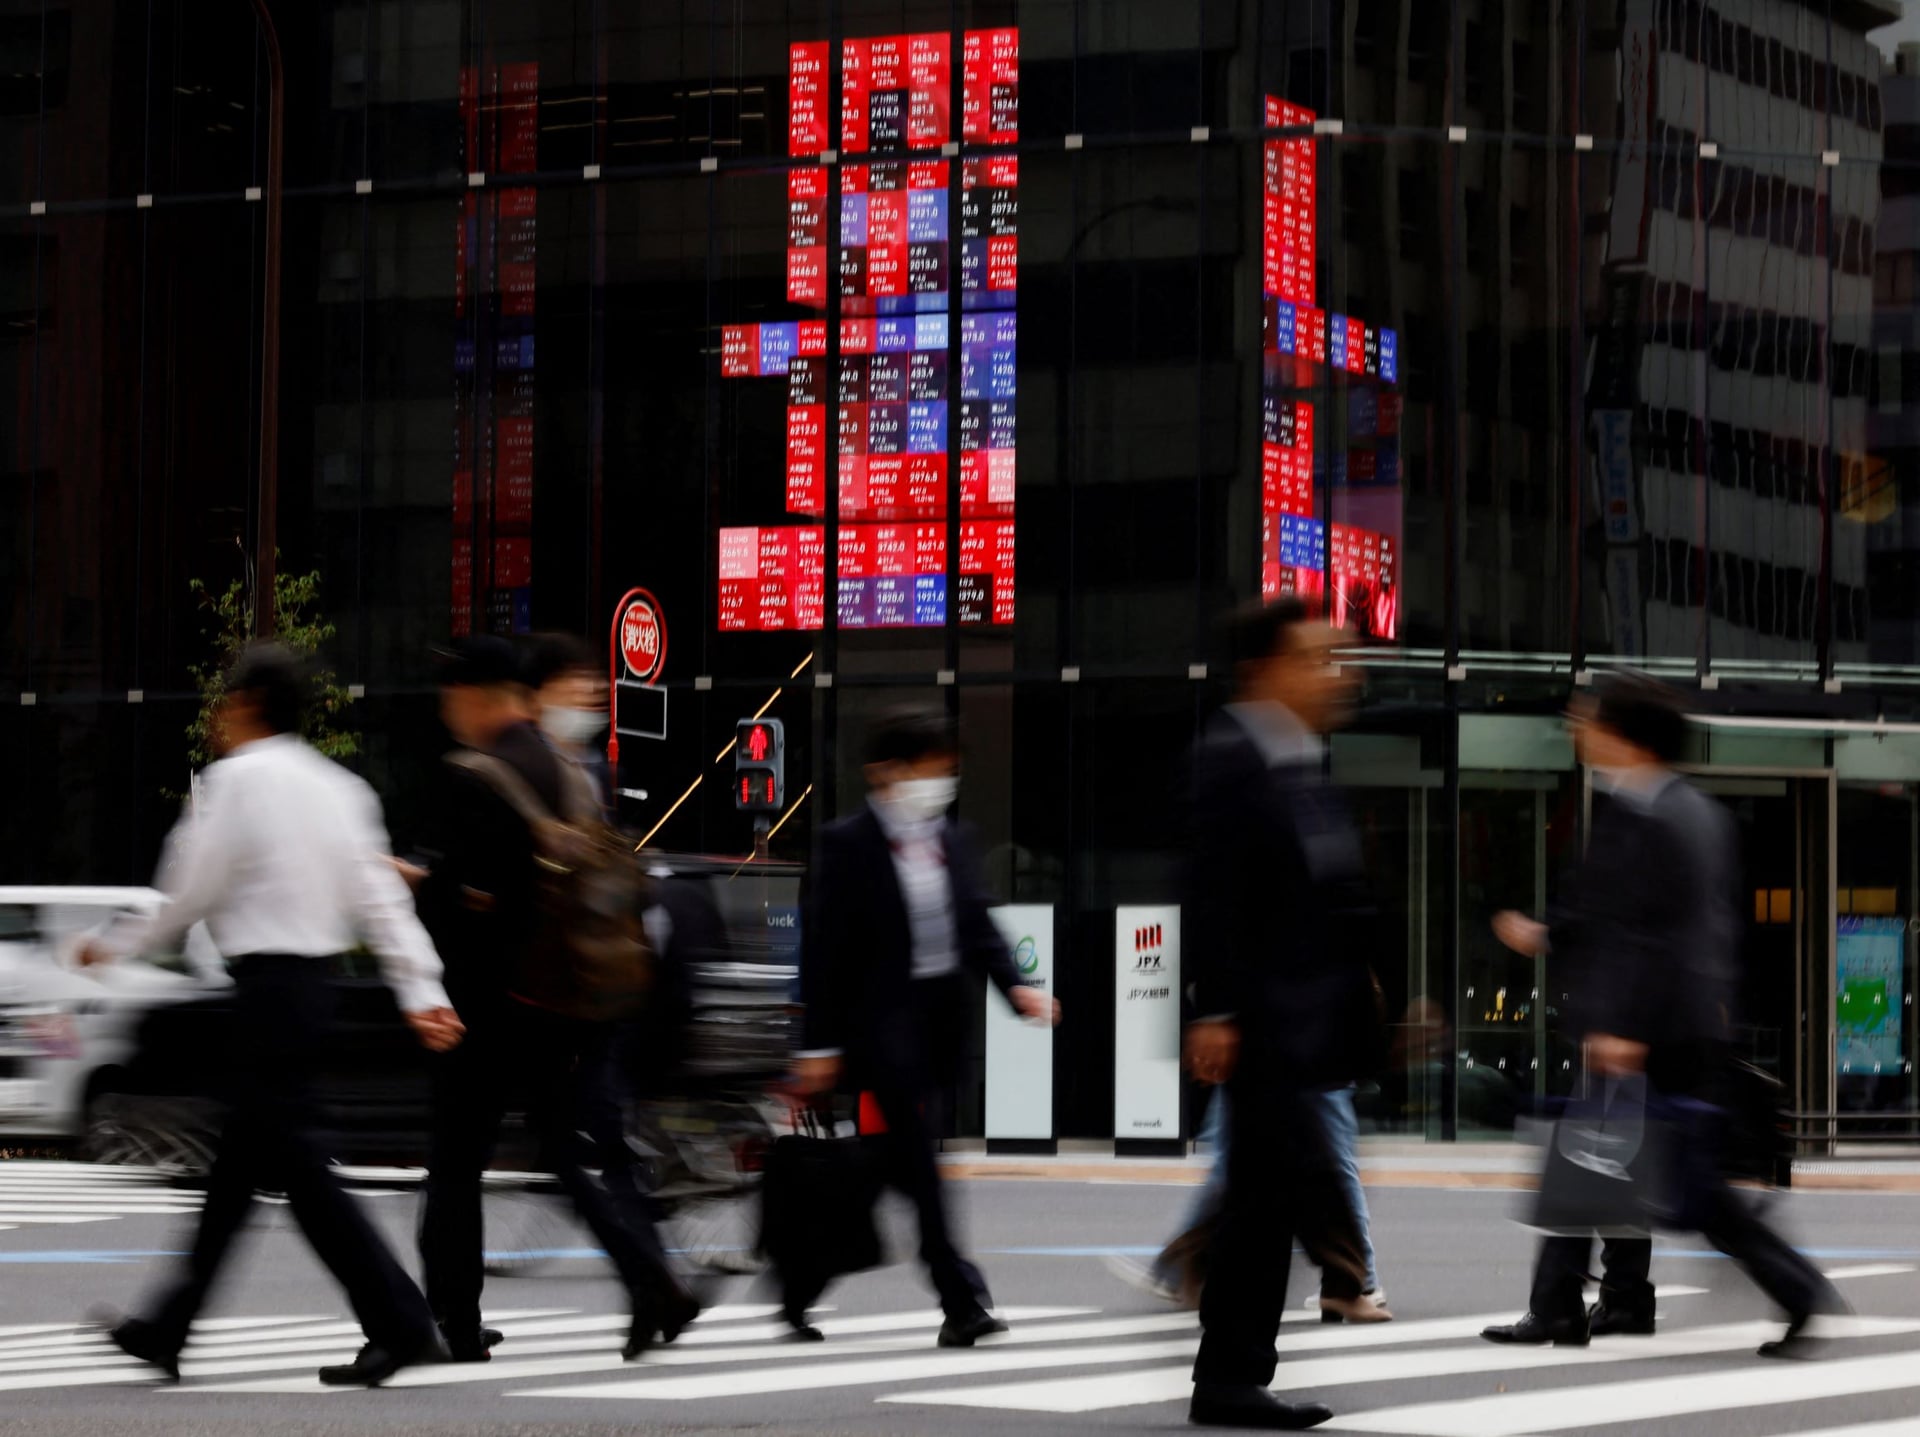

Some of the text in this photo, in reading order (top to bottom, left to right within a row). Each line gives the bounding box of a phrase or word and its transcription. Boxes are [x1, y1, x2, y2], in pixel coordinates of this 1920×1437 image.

[792, 213, 818, 227] 1144.0
[871, 207, 899, 222] 1827.0
[763, 338, 790, 352] 1210.0
[790, 423, 818, 436] 6212.0
[911, 418, 939, 431] 7794.0
[917, 539, 945, 551] 3621.0
[722, 595, 743, 608] 176.7
[760, 594, 787, 607] 4490.0
[917, 590, 945, 603] 1921.0
[625, 623, 655, 655] 消火栓
[1136, 954, 1161, 968] JPX
[1127, 986, 1169, 1001] JPX総研
